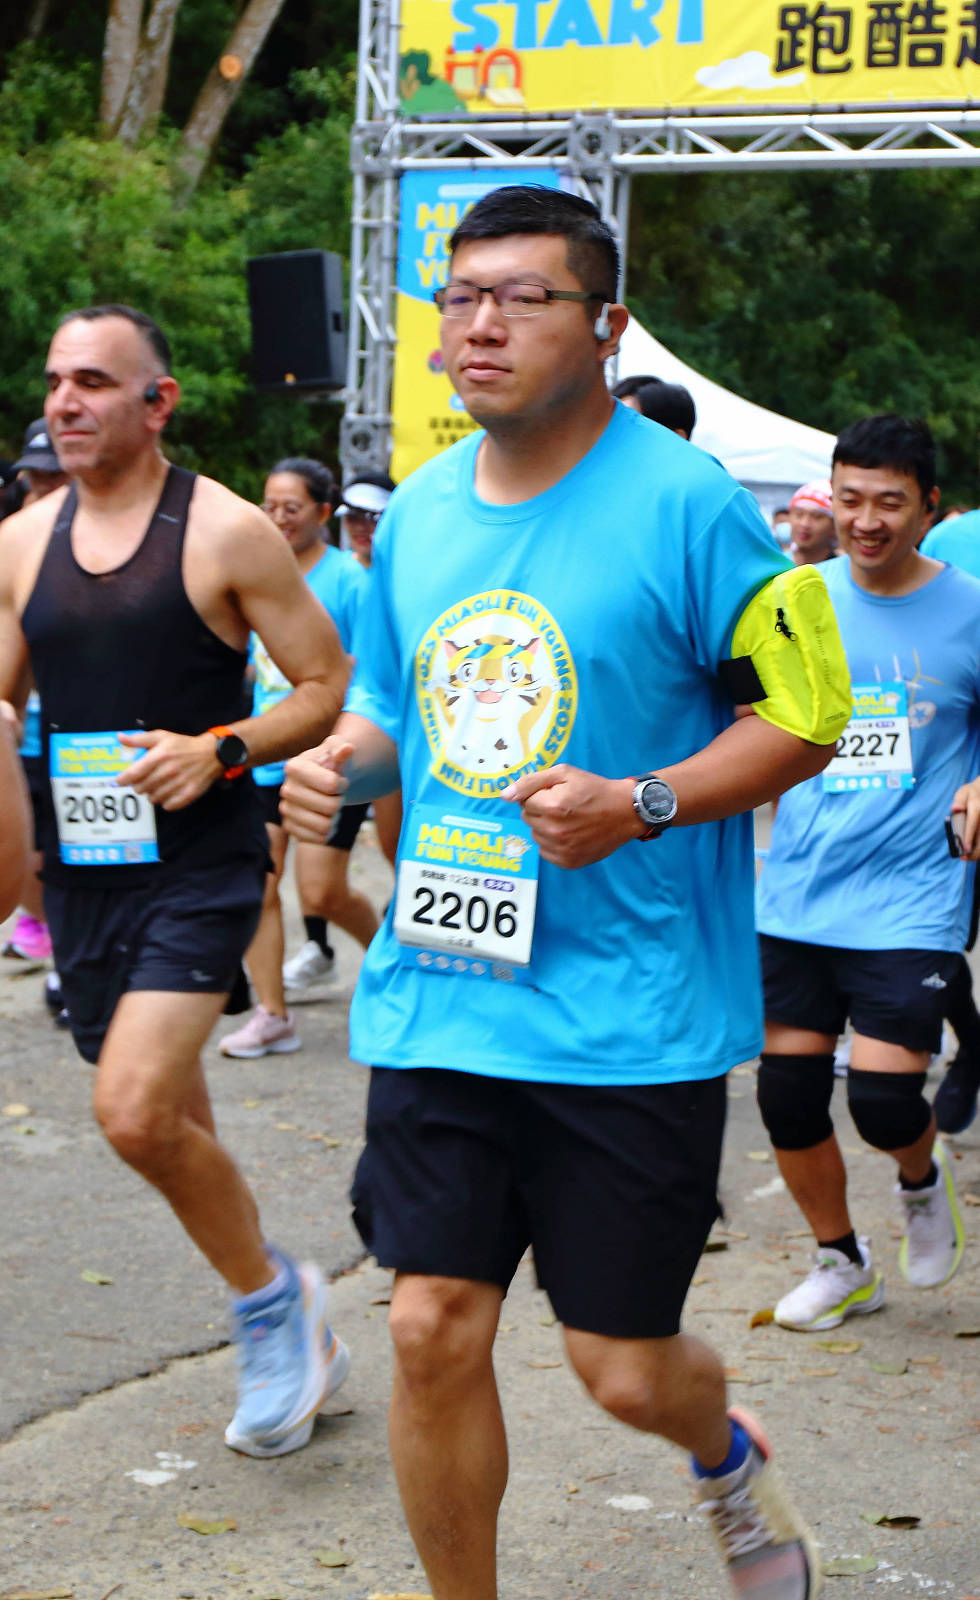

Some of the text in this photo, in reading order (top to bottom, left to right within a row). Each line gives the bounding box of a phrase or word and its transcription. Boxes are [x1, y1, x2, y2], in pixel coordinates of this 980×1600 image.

[450, 0, 704, 52] START
[775, 0, 980, 75] 跑酷
[436, 595, 501, 636] MIAOLI
[505, 595, 541, 623] FUN
[539, 617, 573, 691] YOUNG
[544, 697, 573, 755] 2025
[836, 733, 901, 758] 2227
[63, 794, 141, 823] 2080
[416, 842, 522, 872] FUN YOUNG
[418, 823, 505, 854] MIAOLI
[413, 887, 518, 938] 2206
